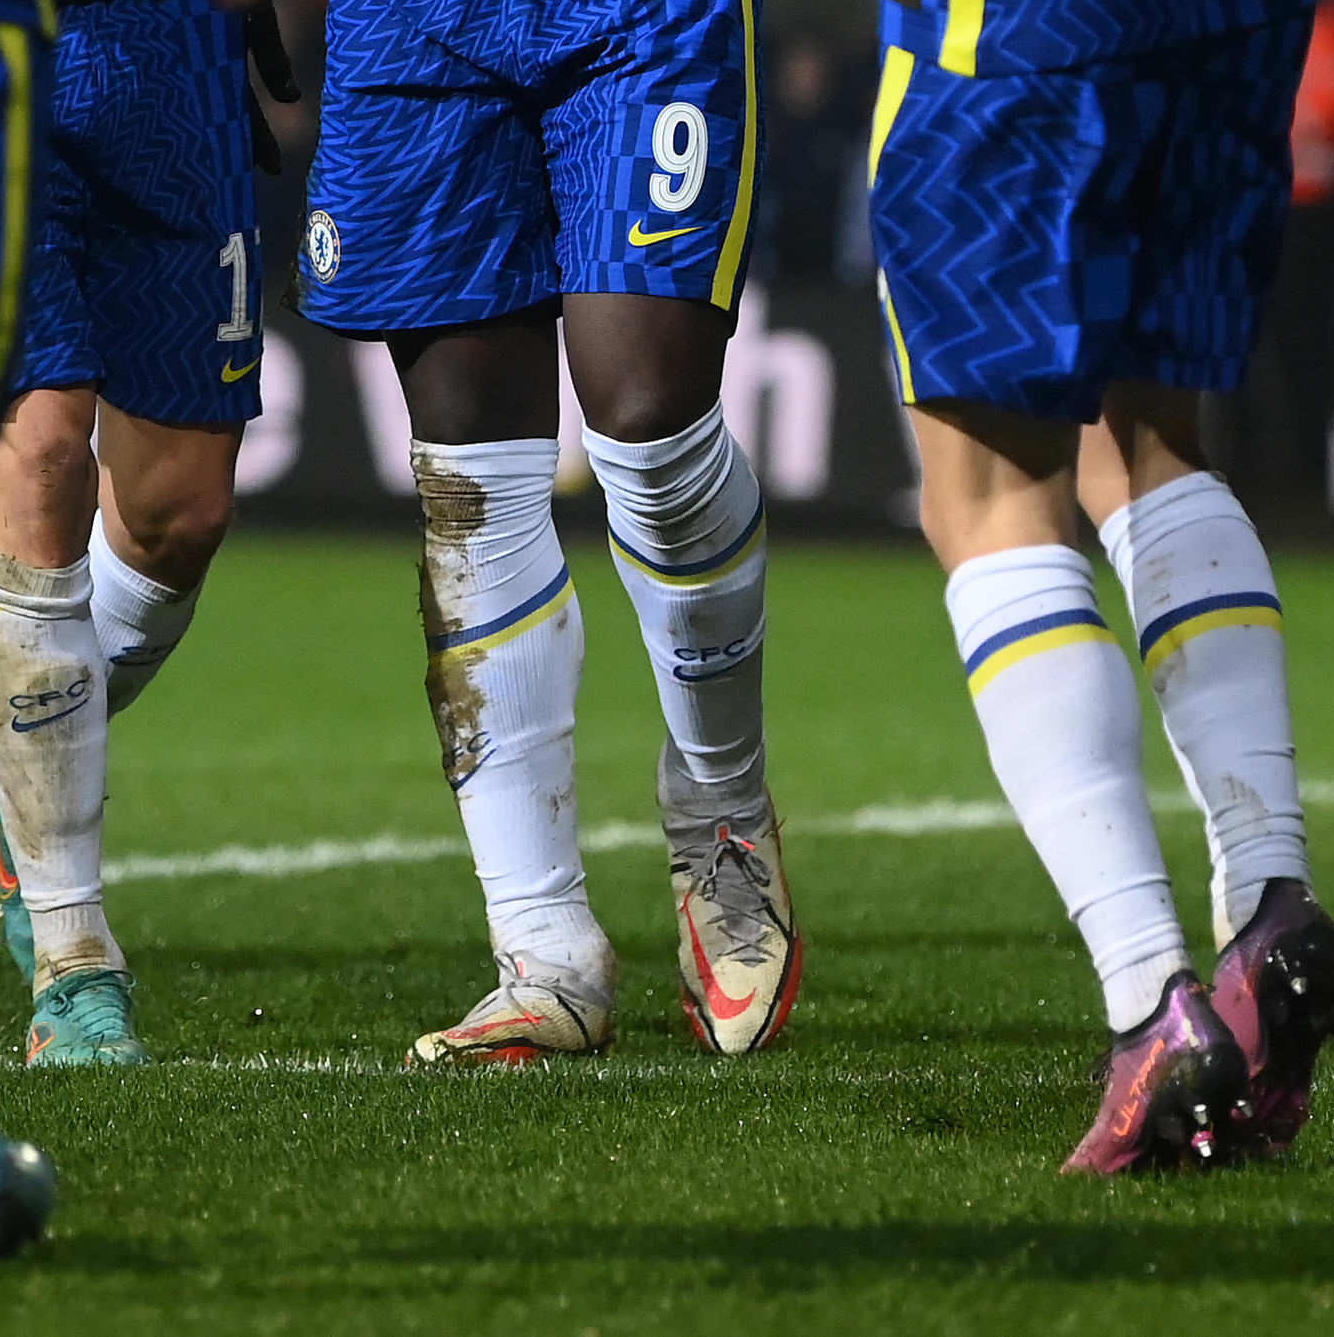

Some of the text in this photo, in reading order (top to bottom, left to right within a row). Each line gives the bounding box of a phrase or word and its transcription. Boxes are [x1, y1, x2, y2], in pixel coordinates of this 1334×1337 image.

[648, 101, 709, 212] 9
[216, 225, 264, 342] 1
[673, 637, 746, 663] CFC
[9, 676, 92, 710] CFC
